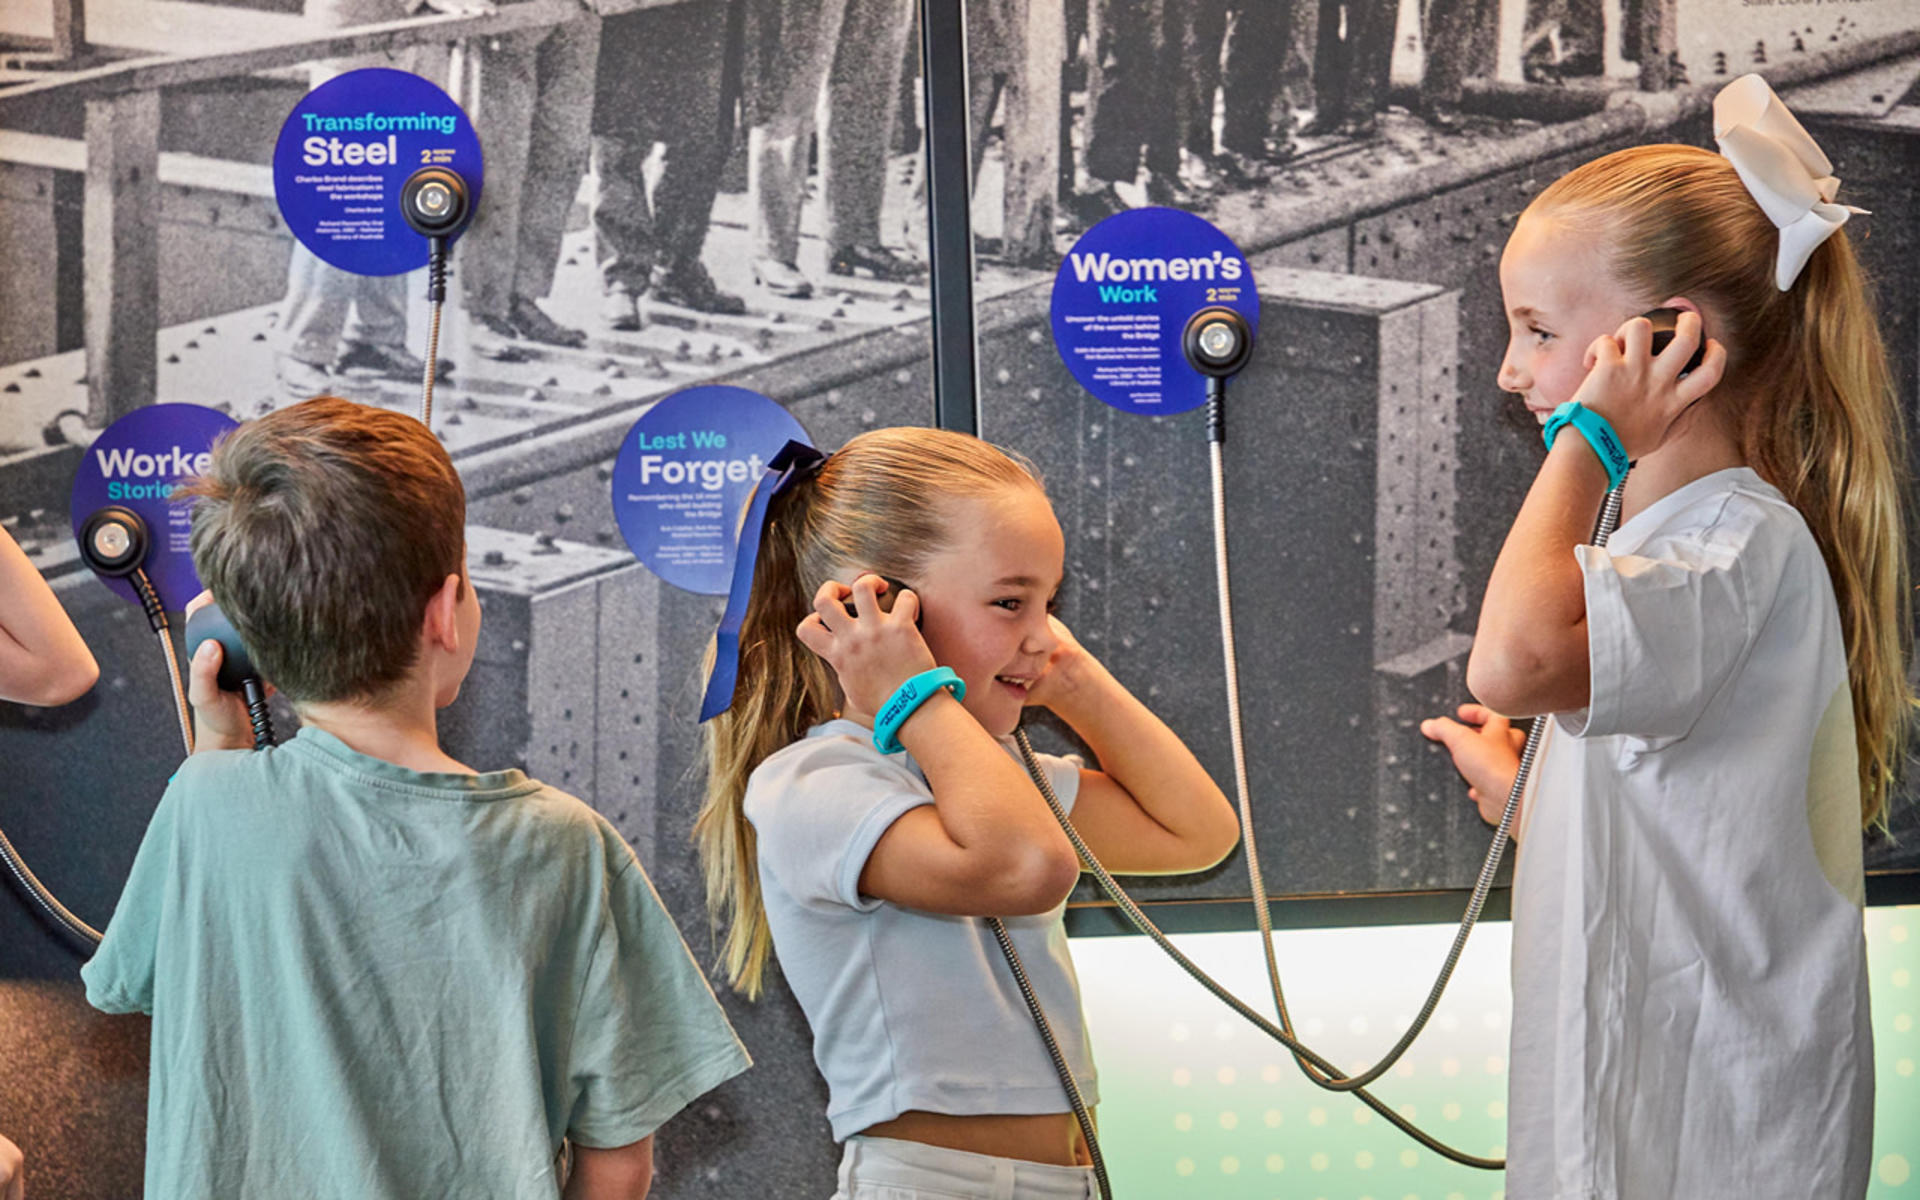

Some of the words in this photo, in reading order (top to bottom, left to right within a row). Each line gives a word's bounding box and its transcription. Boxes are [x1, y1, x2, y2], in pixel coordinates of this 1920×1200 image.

[301, 112, 457, 135] Transforming
[303, 134, 397, 166] Steel
[420, 149, 432, 164] 2
[1070, 250, 1242, 283] Women’s
[1098, 284, 1158, 303] Work
[1206, 287, 1217, 302] 2
[639, 432, 686, 450] Lest
[691, 431, 727, 449] We
[96, 445, 213, 478] Worke
[640, 453, 763, 491] Forget
[108, 480, 184, 499] Storie
